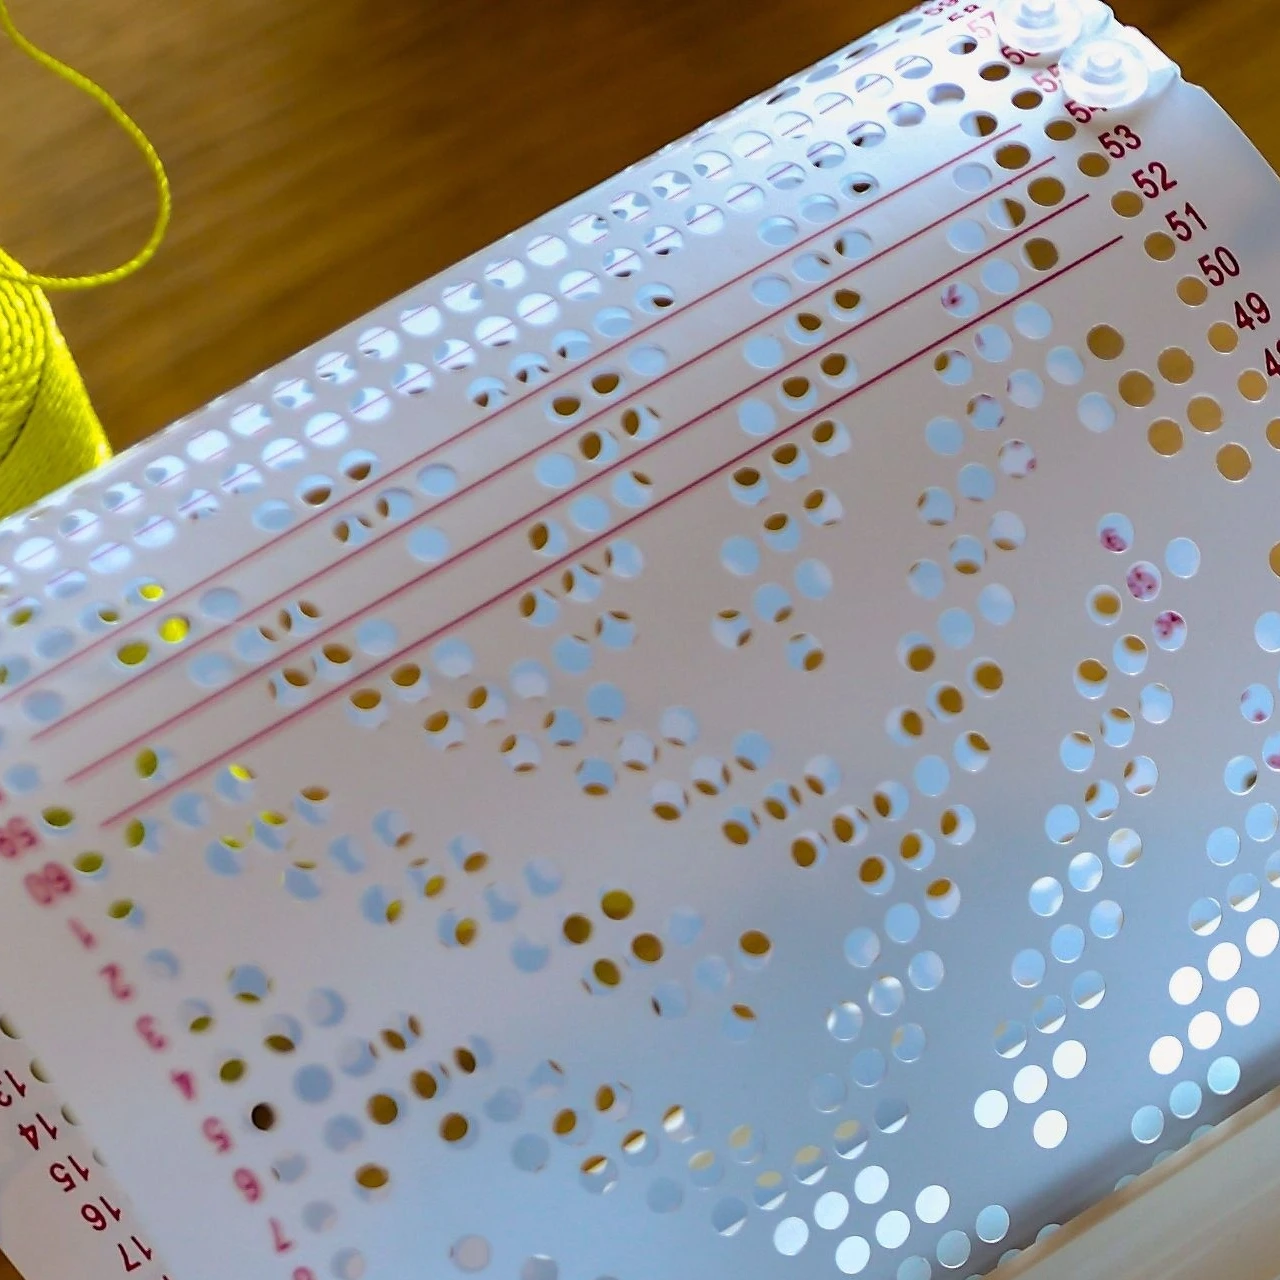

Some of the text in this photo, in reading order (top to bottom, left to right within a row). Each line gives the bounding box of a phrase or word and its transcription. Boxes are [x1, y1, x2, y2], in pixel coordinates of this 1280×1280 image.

[1098, 124, 1142, 159] 53
[1132, 161, 1178, 199] 52
[1165, 202, 1208, 242] 51
[1197, 246, 1240, 287] 50
[1233, 292, 1271, 330] 49
[18, 1112, 57, 1150] 14
[49, 1155, 89, 1193] 15
[233, 1166, 263, 1202] 6
[80, 1196, 121, 1231] 16
[118, 1236, 152, 1272] 17
[268, 1216, 294, 1254] 7
